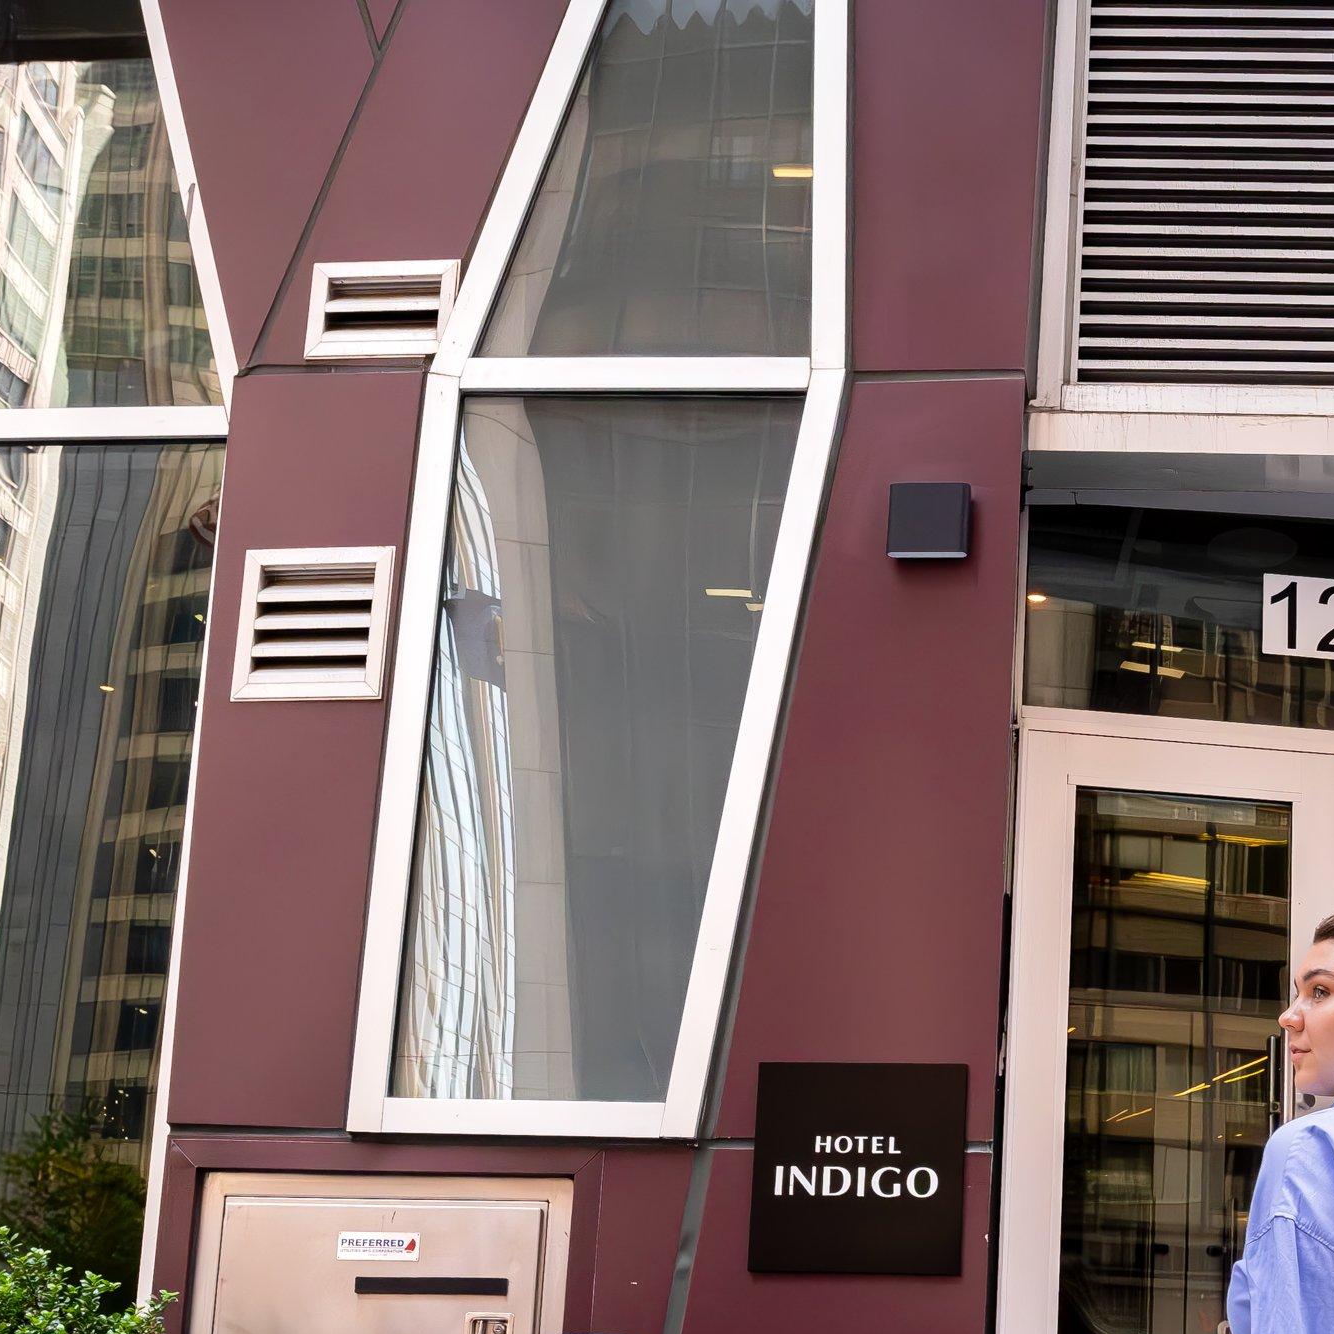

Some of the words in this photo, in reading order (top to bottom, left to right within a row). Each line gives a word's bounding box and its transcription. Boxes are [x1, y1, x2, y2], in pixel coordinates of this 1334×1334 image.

[814, 1135, 902, 1154] HOTEL
[773, 1165, 939, 1198] INDIGO
[341, 1238, 405, 1247] PREFERRED
